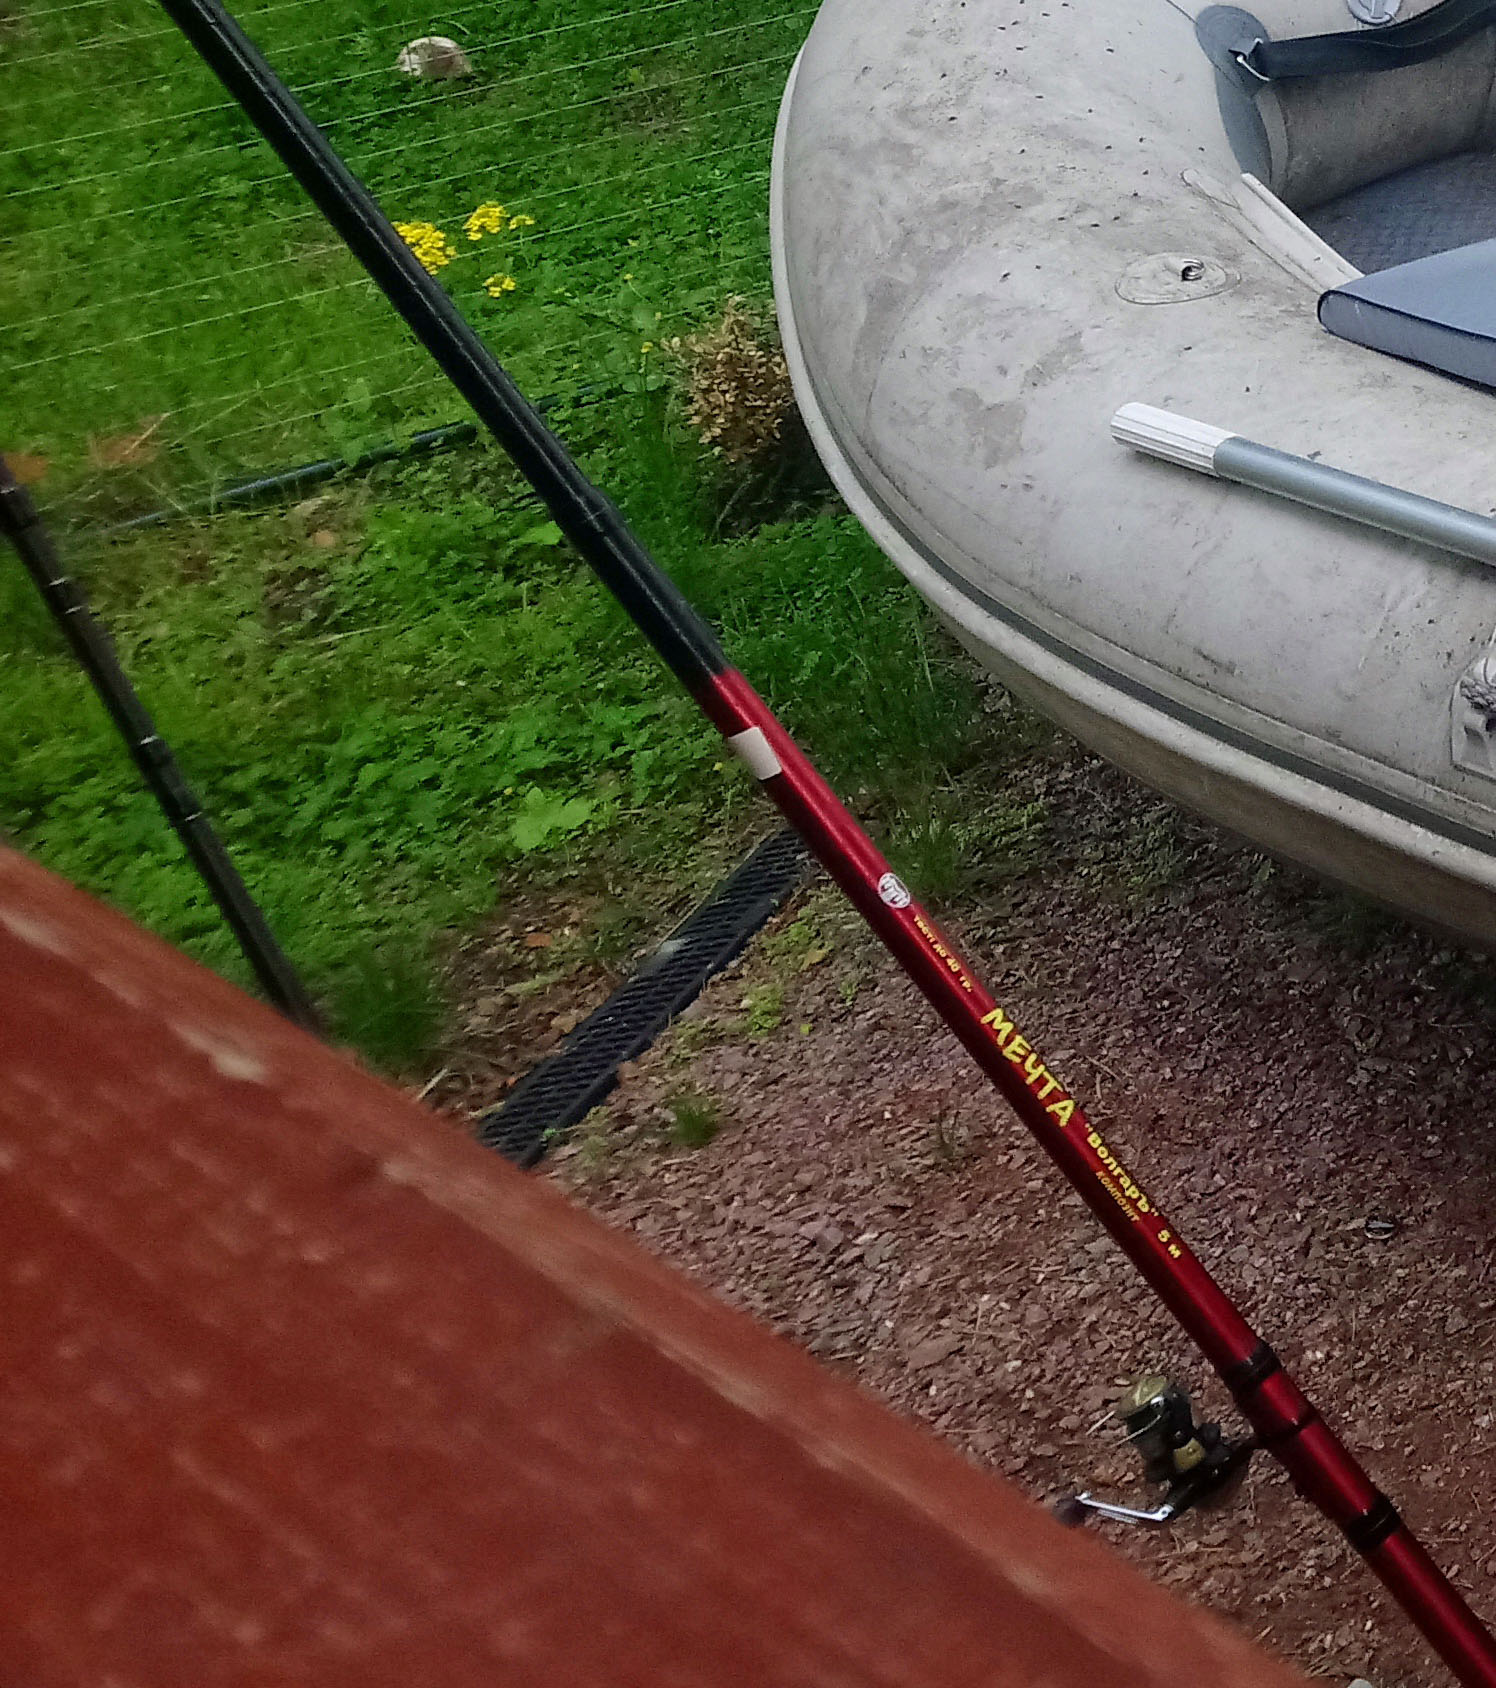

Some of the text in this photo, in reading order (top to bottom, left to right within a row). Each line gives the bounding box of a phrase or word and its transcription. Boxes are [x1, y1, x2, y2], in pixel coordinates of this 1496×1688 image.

[946, 957, 961, 972] 40
[980, 1007, 1076, 1127] МЕЧТА
[1157, 1229, 1171, 1243] 5
